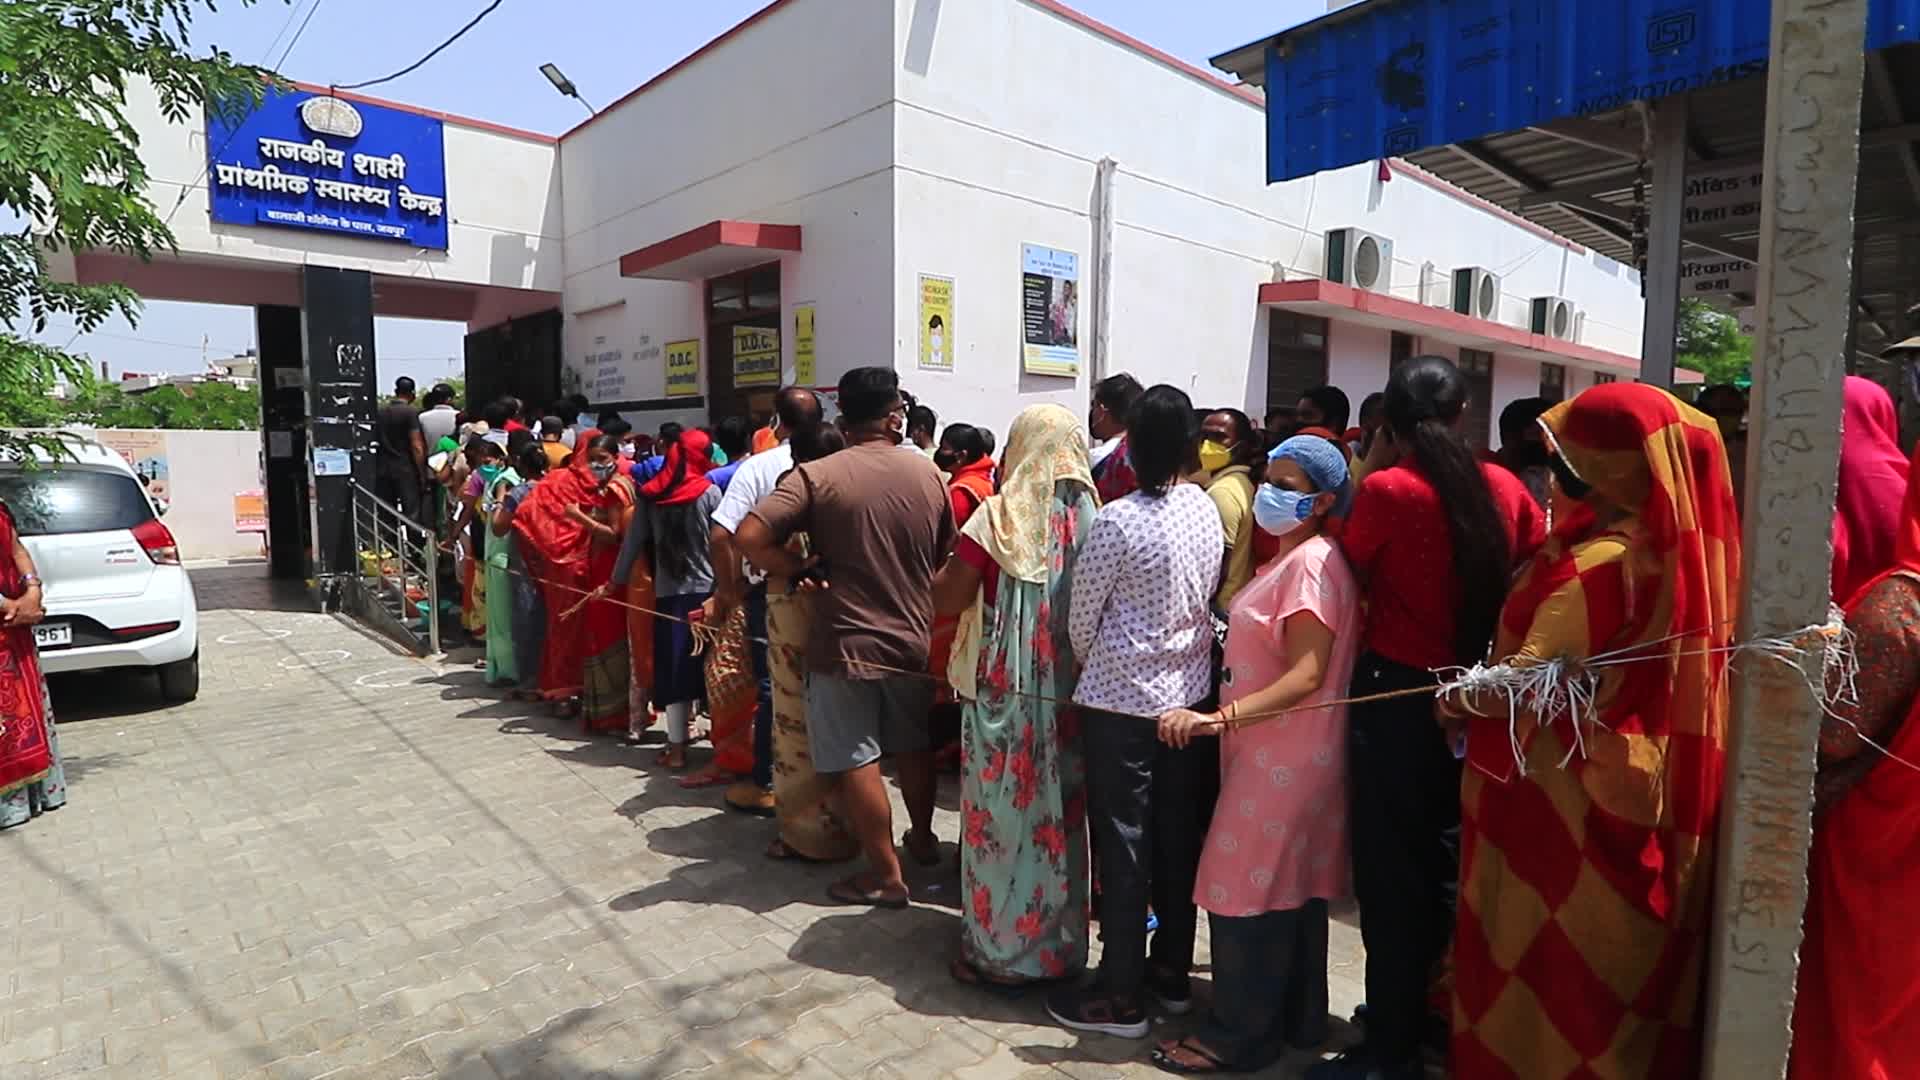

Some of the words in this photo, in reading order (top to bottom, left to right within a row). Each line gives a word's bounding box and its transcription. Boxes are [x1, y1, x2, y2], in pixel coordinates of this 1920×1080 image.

[258, 136, 346, 169] राजकीय
[353, 152, 406, 180] शहरी
[216, 161, 311, 195] प्राथमिक
[314, 178, 391, 208] स्वास्थ्य
[398, 185, 444, 217] केन्द्र
[33, 626, 68, 641] 961
